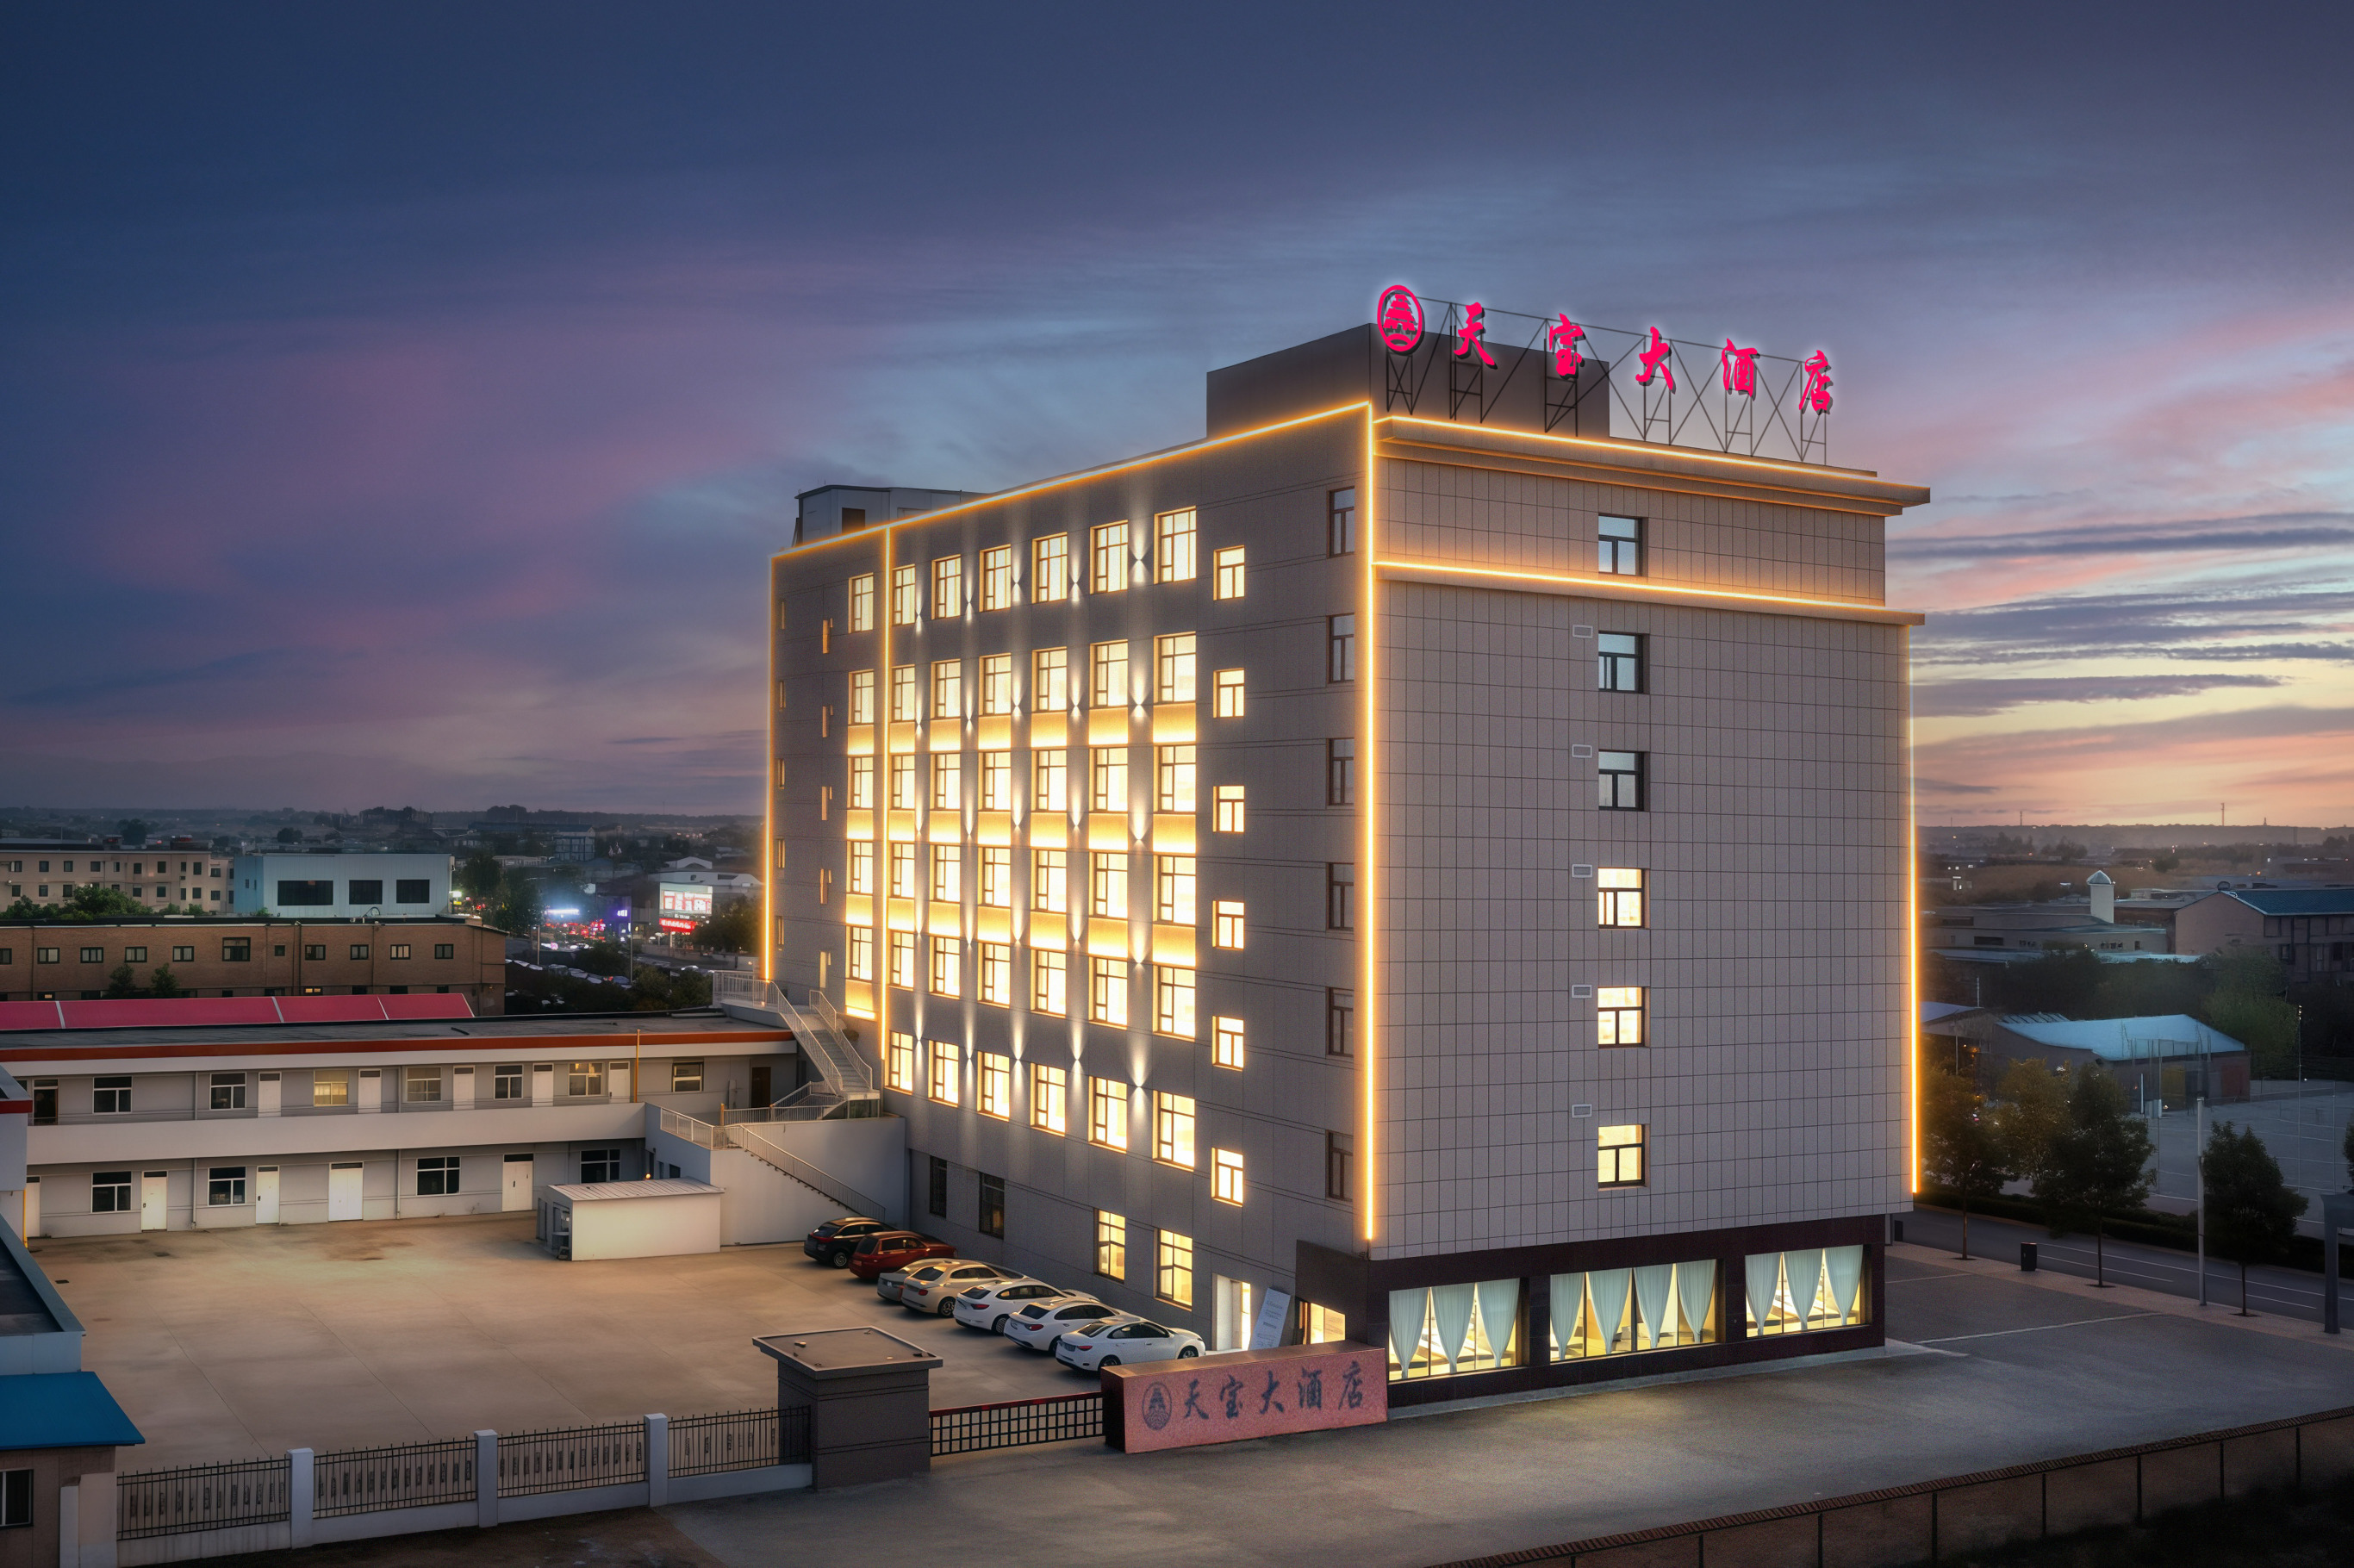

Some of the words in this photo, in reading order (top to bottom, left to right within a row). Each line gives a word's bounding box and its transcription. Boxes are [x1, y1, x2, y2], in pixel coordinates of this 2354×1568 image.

[1454, 301, 1832, 413] 天宝大酒店
[1184, 1360, 1364, 1419] 天宝大酒店
